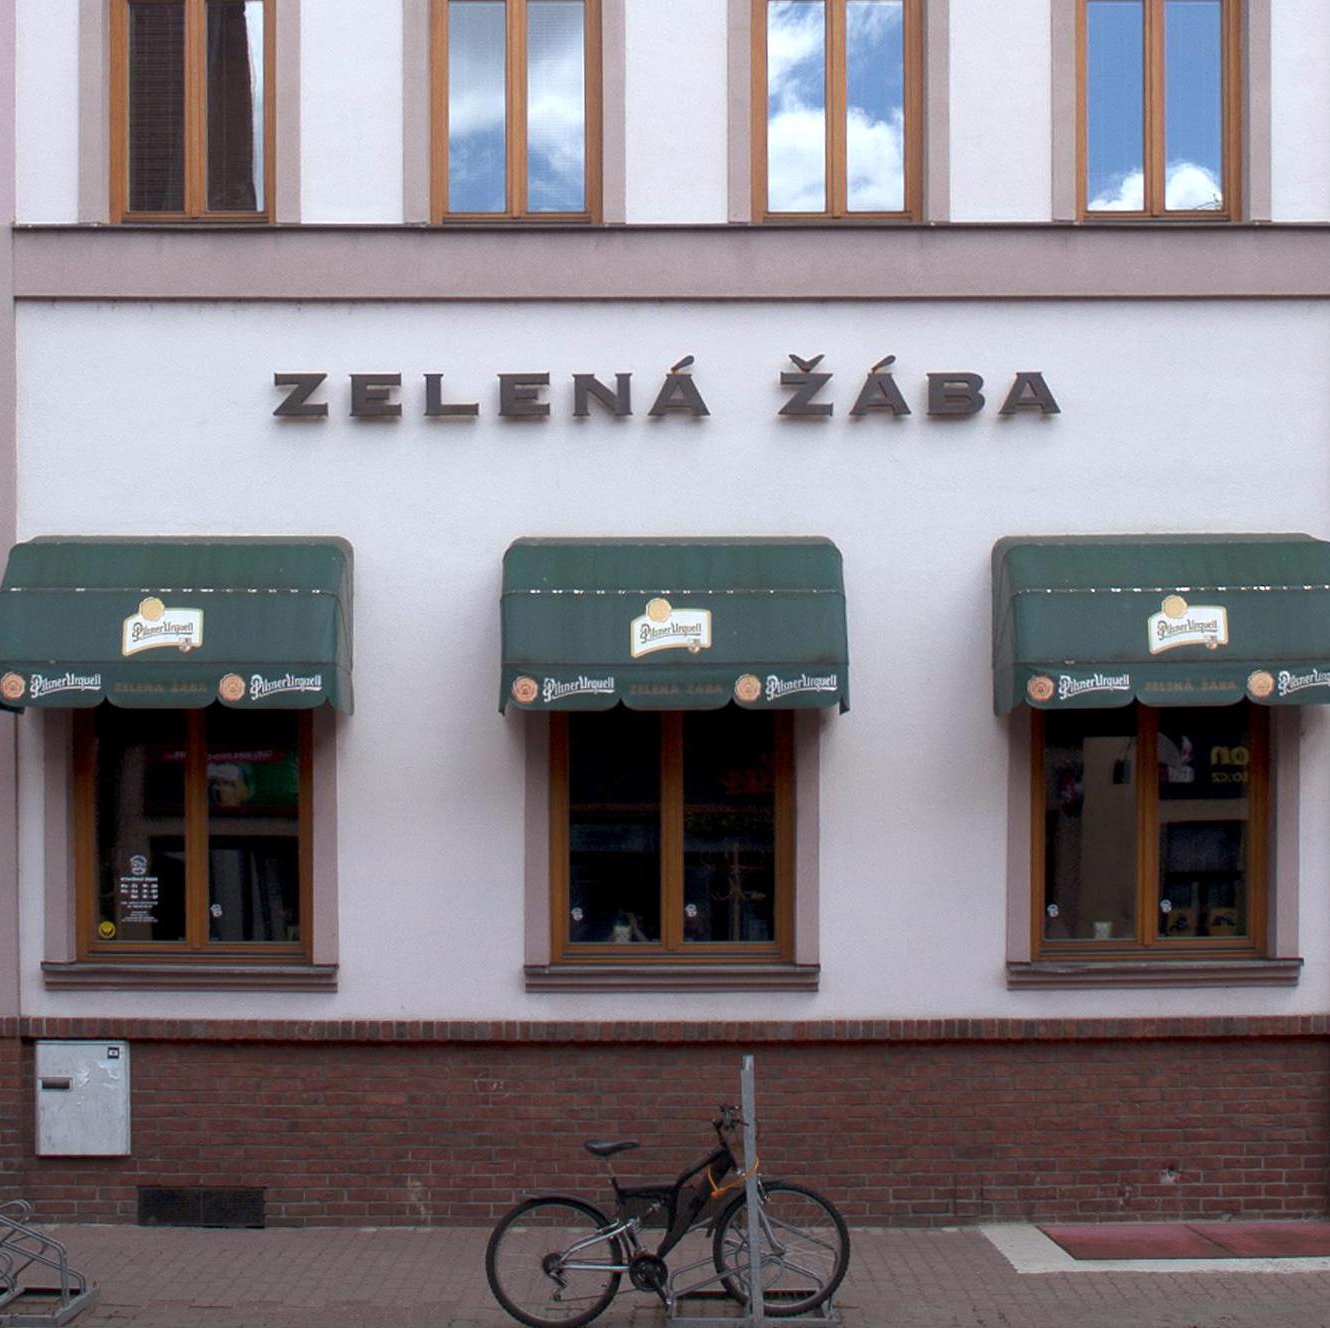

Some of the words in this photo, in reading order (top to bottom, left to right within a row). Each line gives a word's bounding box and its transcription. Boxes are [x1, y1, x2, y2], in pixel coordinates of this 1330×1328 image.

[273, 355, 711, 417] ZELENÁ
[778, 354, 1063, 417] ŽÁBA
[639, 623, 671, 644] Pilsner
[670, 621, 702, 637] Urquell
[30, 674, 68, 699] Pilsner
[65, 672, 102, 691] Urquell
[249, 674, 289, 700] Pilsner
[285, 672, 323, 691] Urquell
[543, 677, 581, 703] Pilsner
[579, 675, 615, 694] Urquell
[765, 675, 805, 702] Pilsner
[802, 674, 838, 693] Urquell
[1058, 675, 1095, 700] Pilsner
[1094, 673, 1130, 691] Urquell
[1278, 669, 1314, 696] Pilsner
